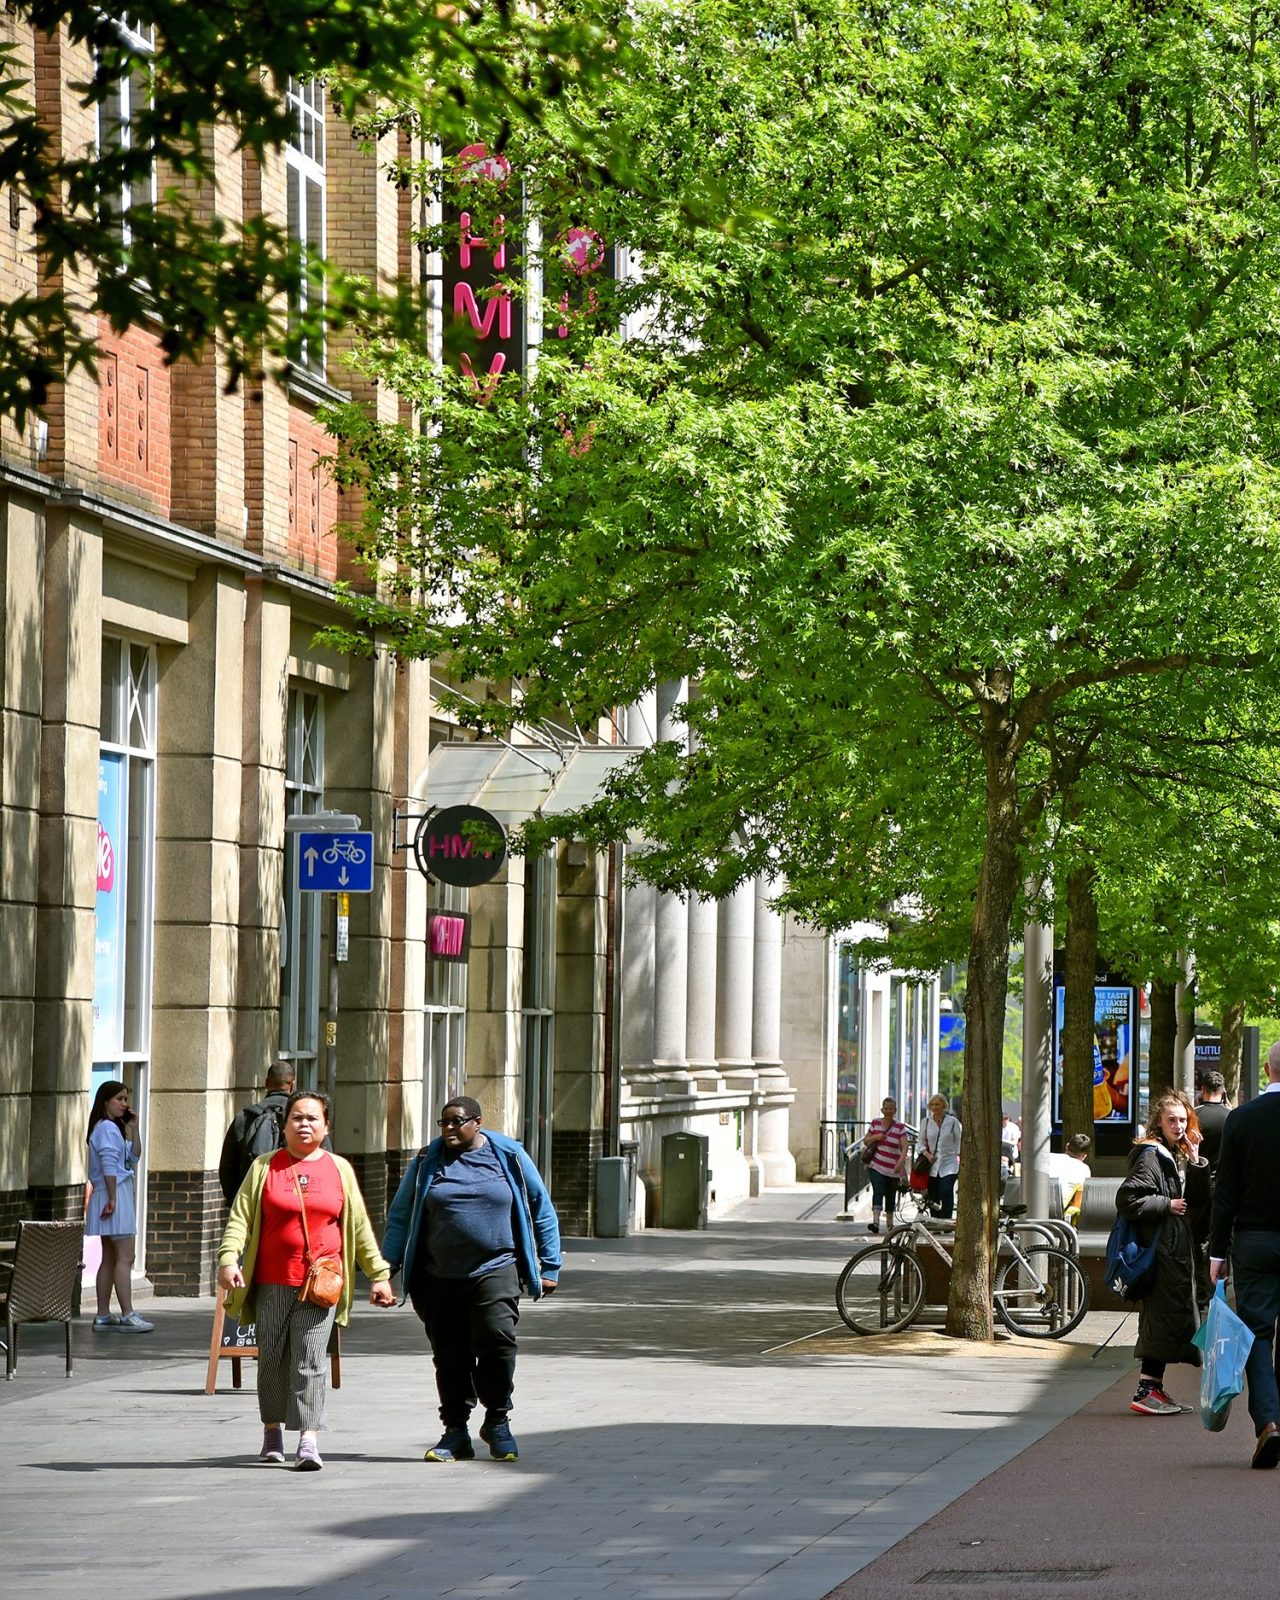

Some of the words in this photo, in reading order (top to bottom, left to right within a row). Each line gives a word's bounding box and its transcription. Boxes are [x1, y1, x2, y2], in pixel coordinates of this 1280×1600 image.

[429, 834, 491, 859] HM
[1096, 992, 1105, 1000] HE
[1107, 992, 1128, 1000] TASTE
[327, 1024, 336, 1033] S
[327, 1035, 336, 1044] 3
